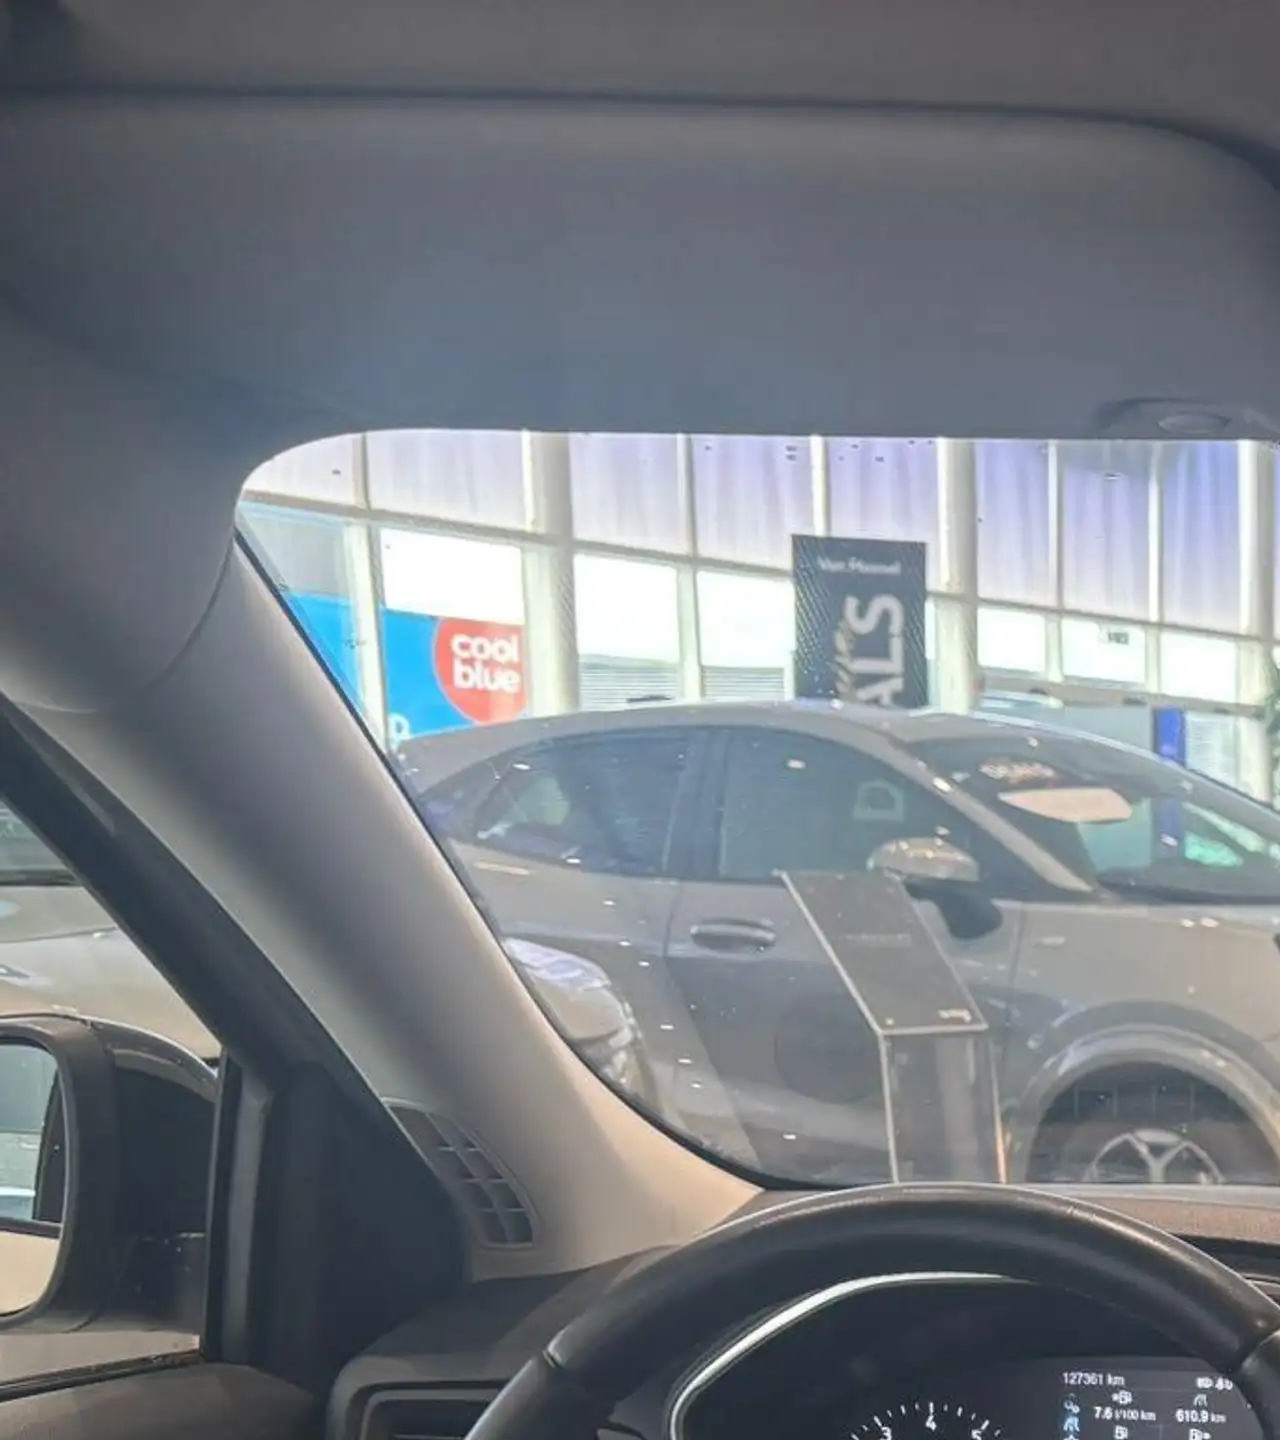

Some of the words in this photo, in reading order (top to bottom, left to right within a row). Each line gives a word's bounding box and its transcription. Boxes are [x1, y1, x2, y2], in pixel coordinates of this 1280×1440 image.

[450, 634, 519, 663] cool
[453, 662, 520, 692] blue
[1062, 1372, 1104, 1386] 127361
[1107, 1373, 1126, 1386] km
[1140, 1409, 1156, 1421] km
[1176, 1409, 1208, 1423] 610.9
[1210, 1412, 1227, 1424] km
[925, 1415, 937, 1431] 4
